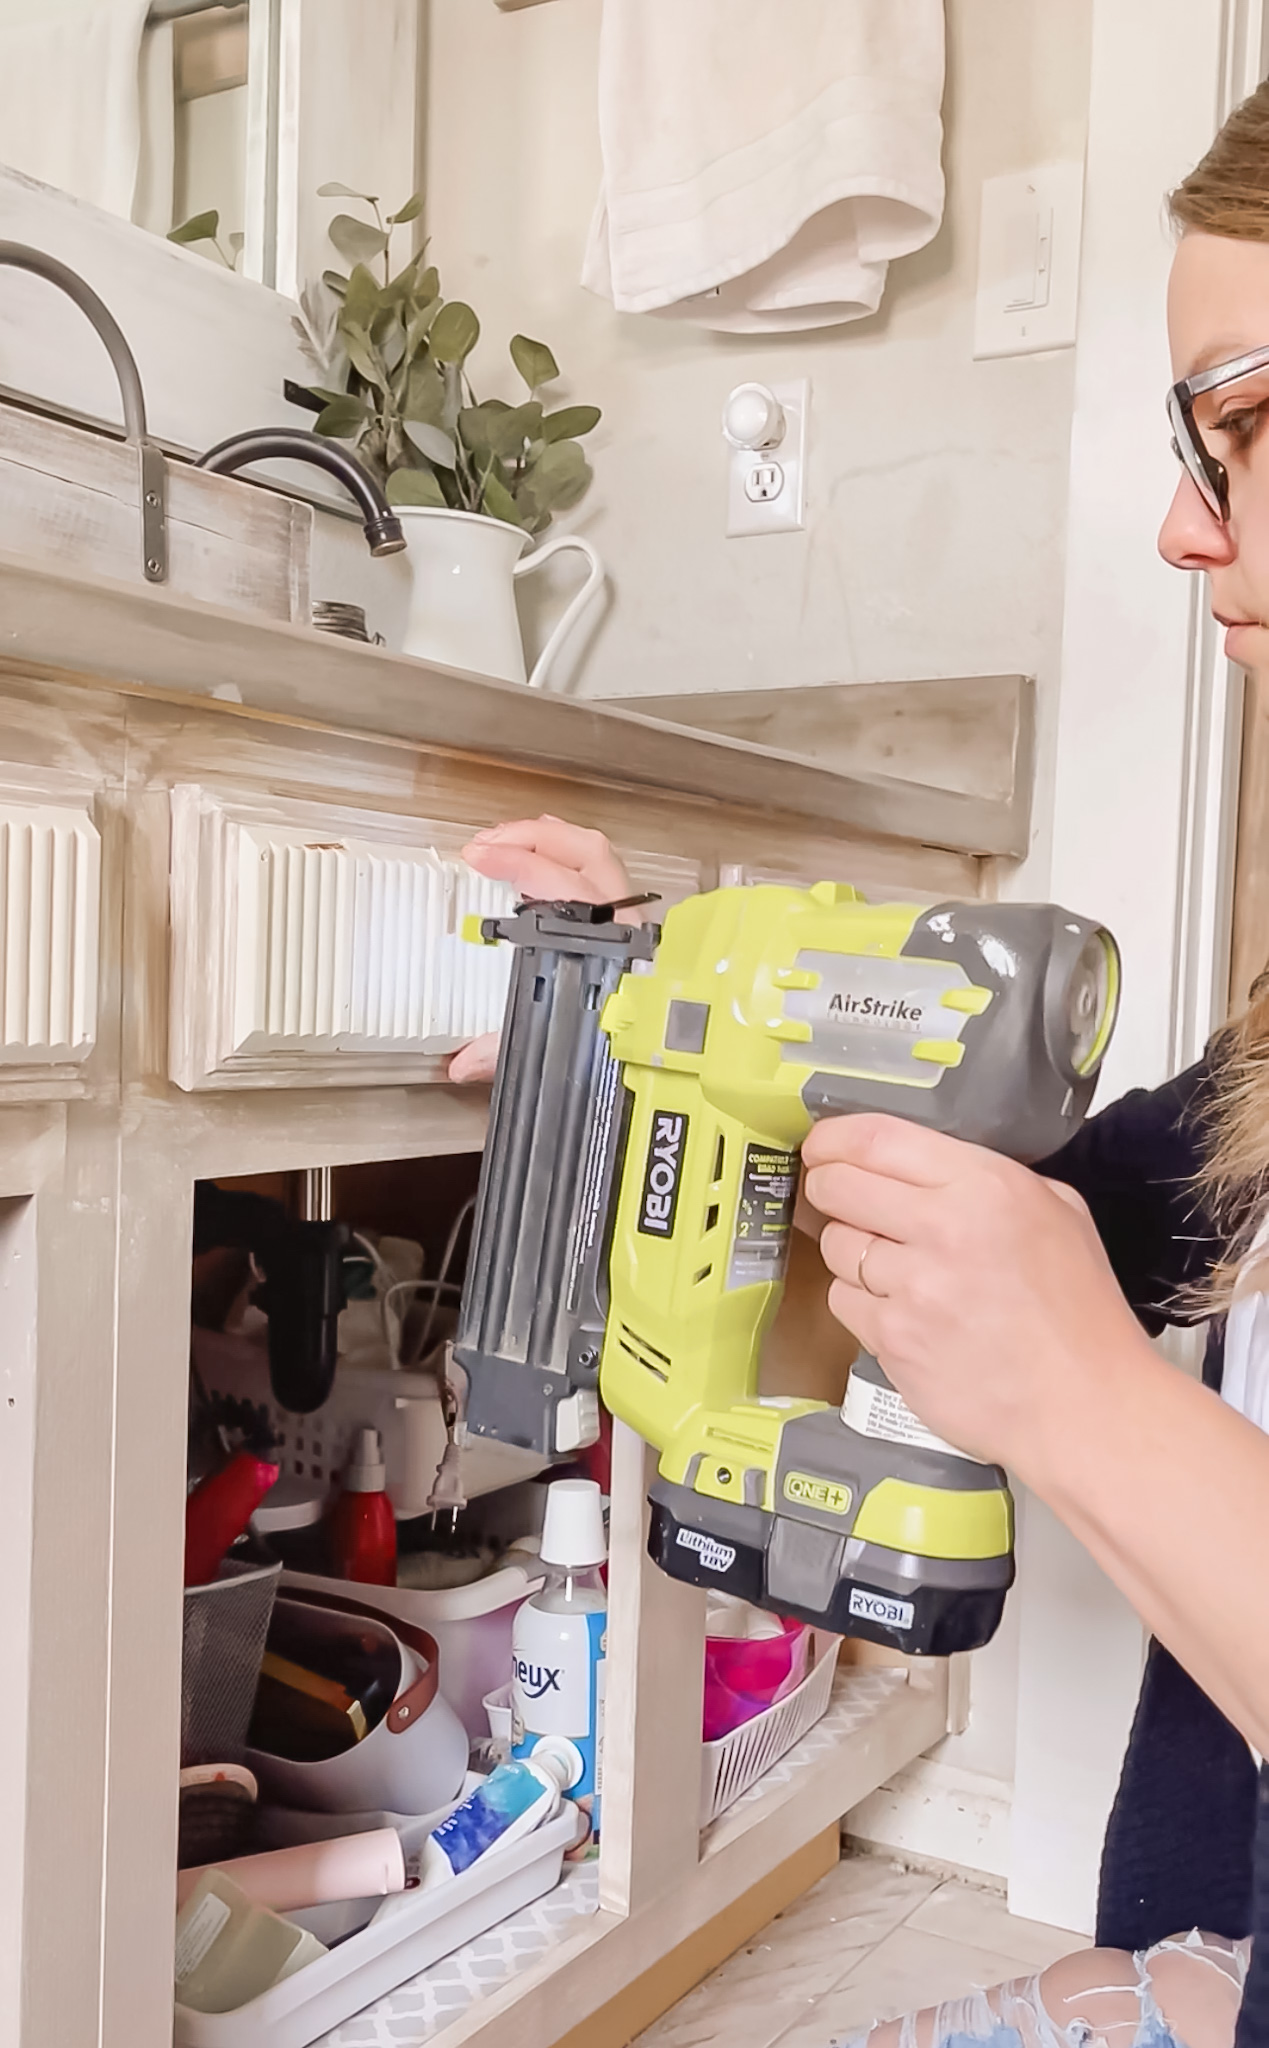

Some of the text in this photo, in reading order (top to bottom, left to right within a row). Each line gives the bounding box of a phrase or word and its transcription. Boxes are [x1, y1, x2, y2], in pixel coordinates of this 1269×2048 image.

[829, 993, 923, 1021] AirStrike
[644, 1116, 683, 1230] RYOBI
[680, 1531, 733, 1559] Lithium
[853, 1594, 903, 1621] RYOBI
